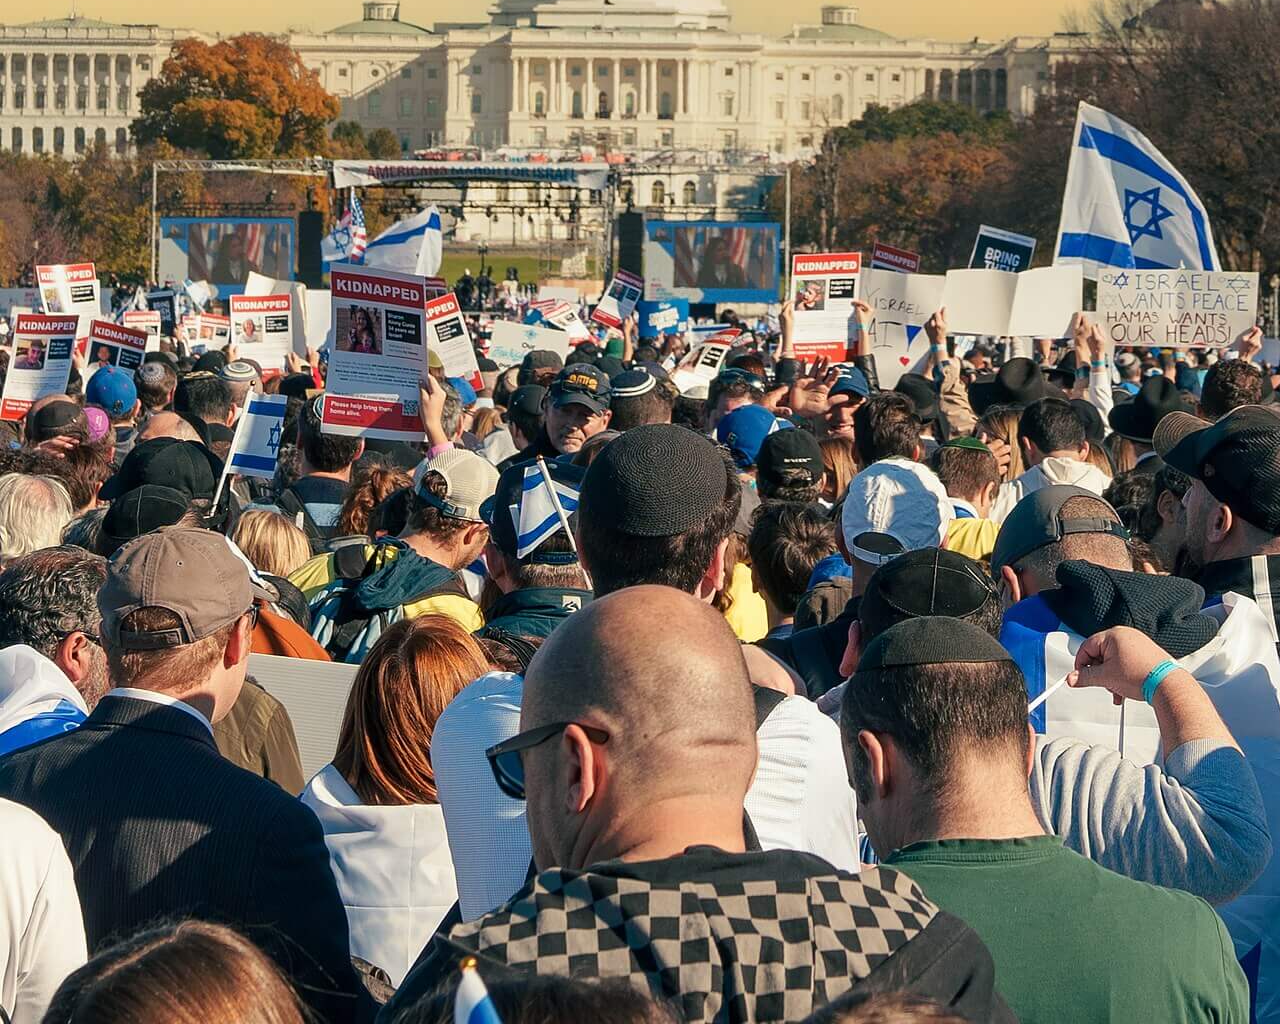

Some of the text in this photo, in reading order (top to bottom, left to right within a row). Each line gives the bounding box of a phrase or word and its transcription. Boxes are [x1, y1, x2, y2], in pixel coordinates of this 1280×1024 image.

[875, 250, 916, 268] KIDNAPPED
[984, 246, 1020, 267] BRING
[796, 260, 857, 272] KIDNAPPED
[336, 279, 420, 301] KIDNAPPED
[1136, 274, 1219, 291] ISRAEL
[234, 301, 288, 310] KIDNAPPED
[1118, 292, 1249, 312] WANTS PEACE
[19, 321, 76, 331] KIDNAPPED
[1106, 312, 1228, 325] HAMAS WANTS
[94, 326, 145, 346] KIDNAPPED
[1111, 323, 1231, 344] OUR HEADS!
[329, 408, 346, 416] home
[330, 400, 349, 408] Please
[363, 403, 378, 413] bring
